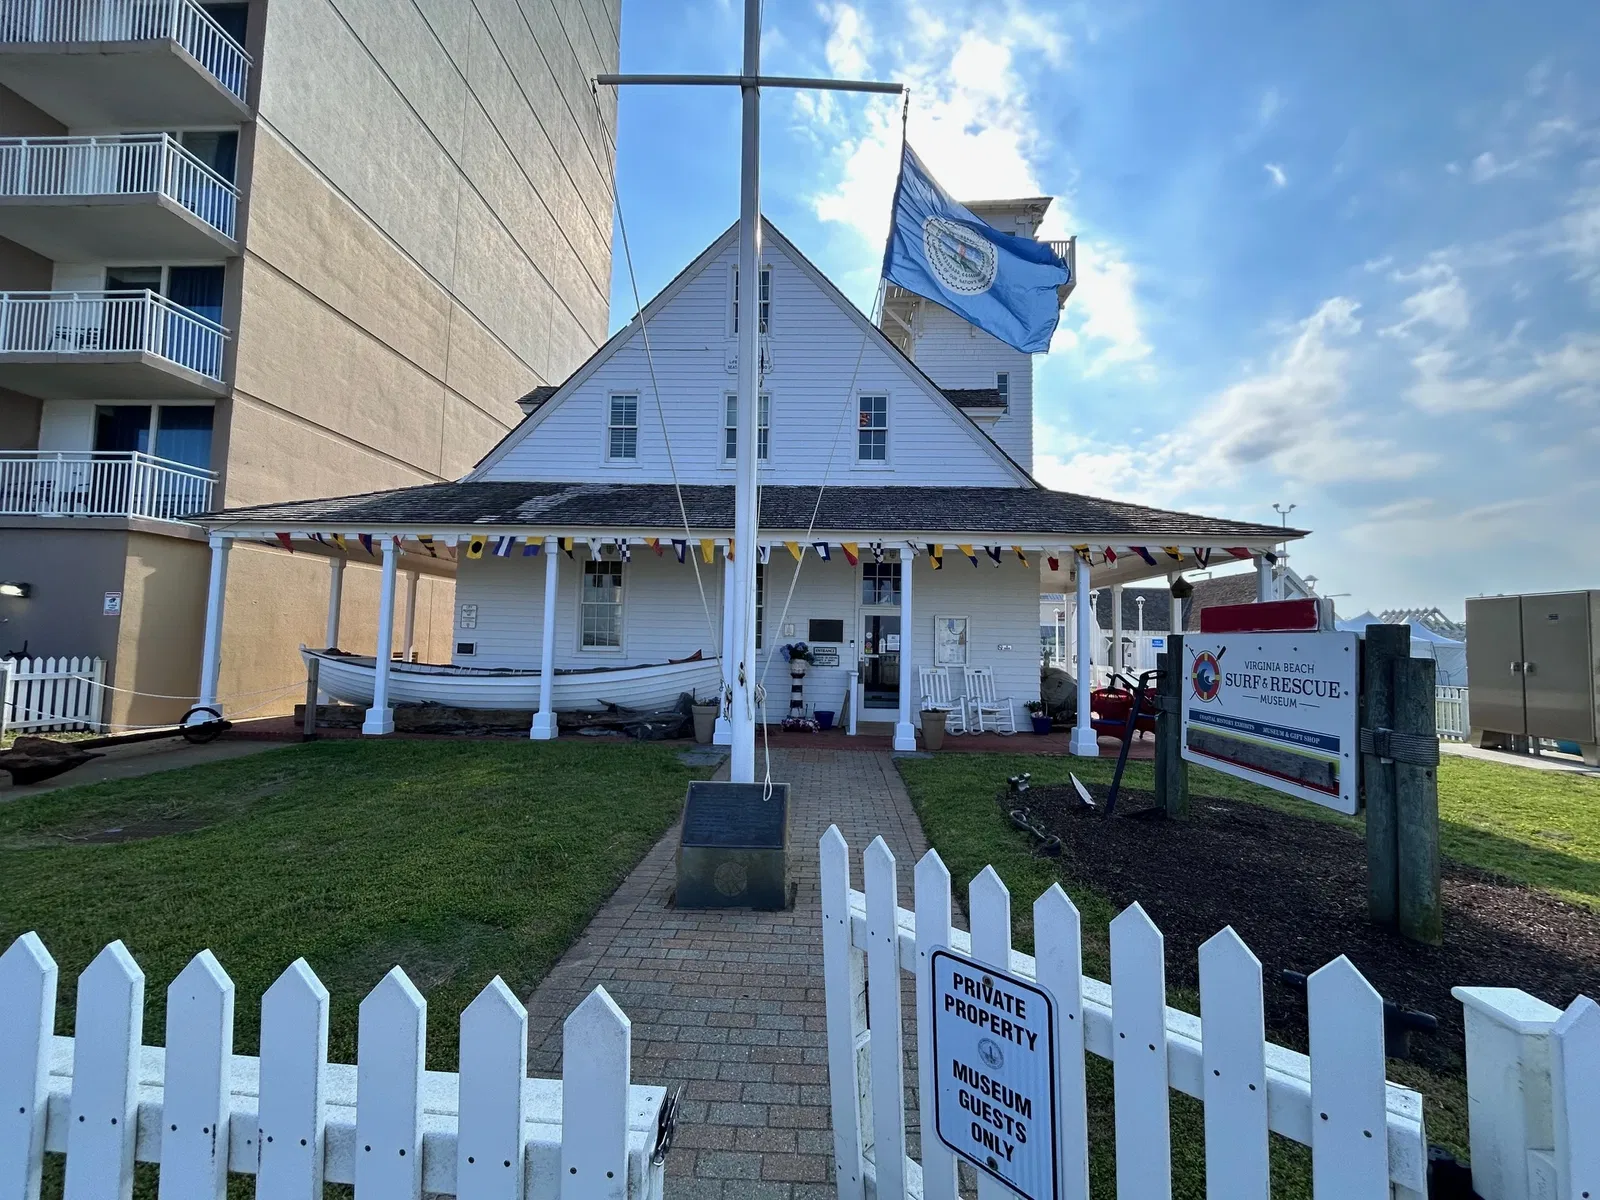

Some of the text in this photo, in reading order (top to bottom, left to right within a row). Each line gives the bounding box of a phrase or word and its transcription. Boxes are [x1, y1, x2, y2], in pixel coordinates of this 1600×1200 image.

[1225, 672, 1261, 689] SURF
[1270, 676, 1340, 698] RESCUE
[1244, 660, 1314, 674] VIRGINIA BEACH
[1260, 694, 1297, 708] MUSEUM
[1216, 717, 1234, 726] HISTORY
[1234, 721, 1255, 730] EXHIBITS
[1262, 727, 1284, 737] MUSEUM
[1290, 732, 1303, 741] GIFT
[1304, 735, 1320, 744] SHOP
[953, 972, 1026, 1020] PRIVATE
[944, 993, 1038, 1052] PROPERTY
[952, 1059, 1032, 1120] MUSEUM
[959, 1089, 1027, 1144] GUESTS
[971, 1122, 1014, 1163] ONLY
